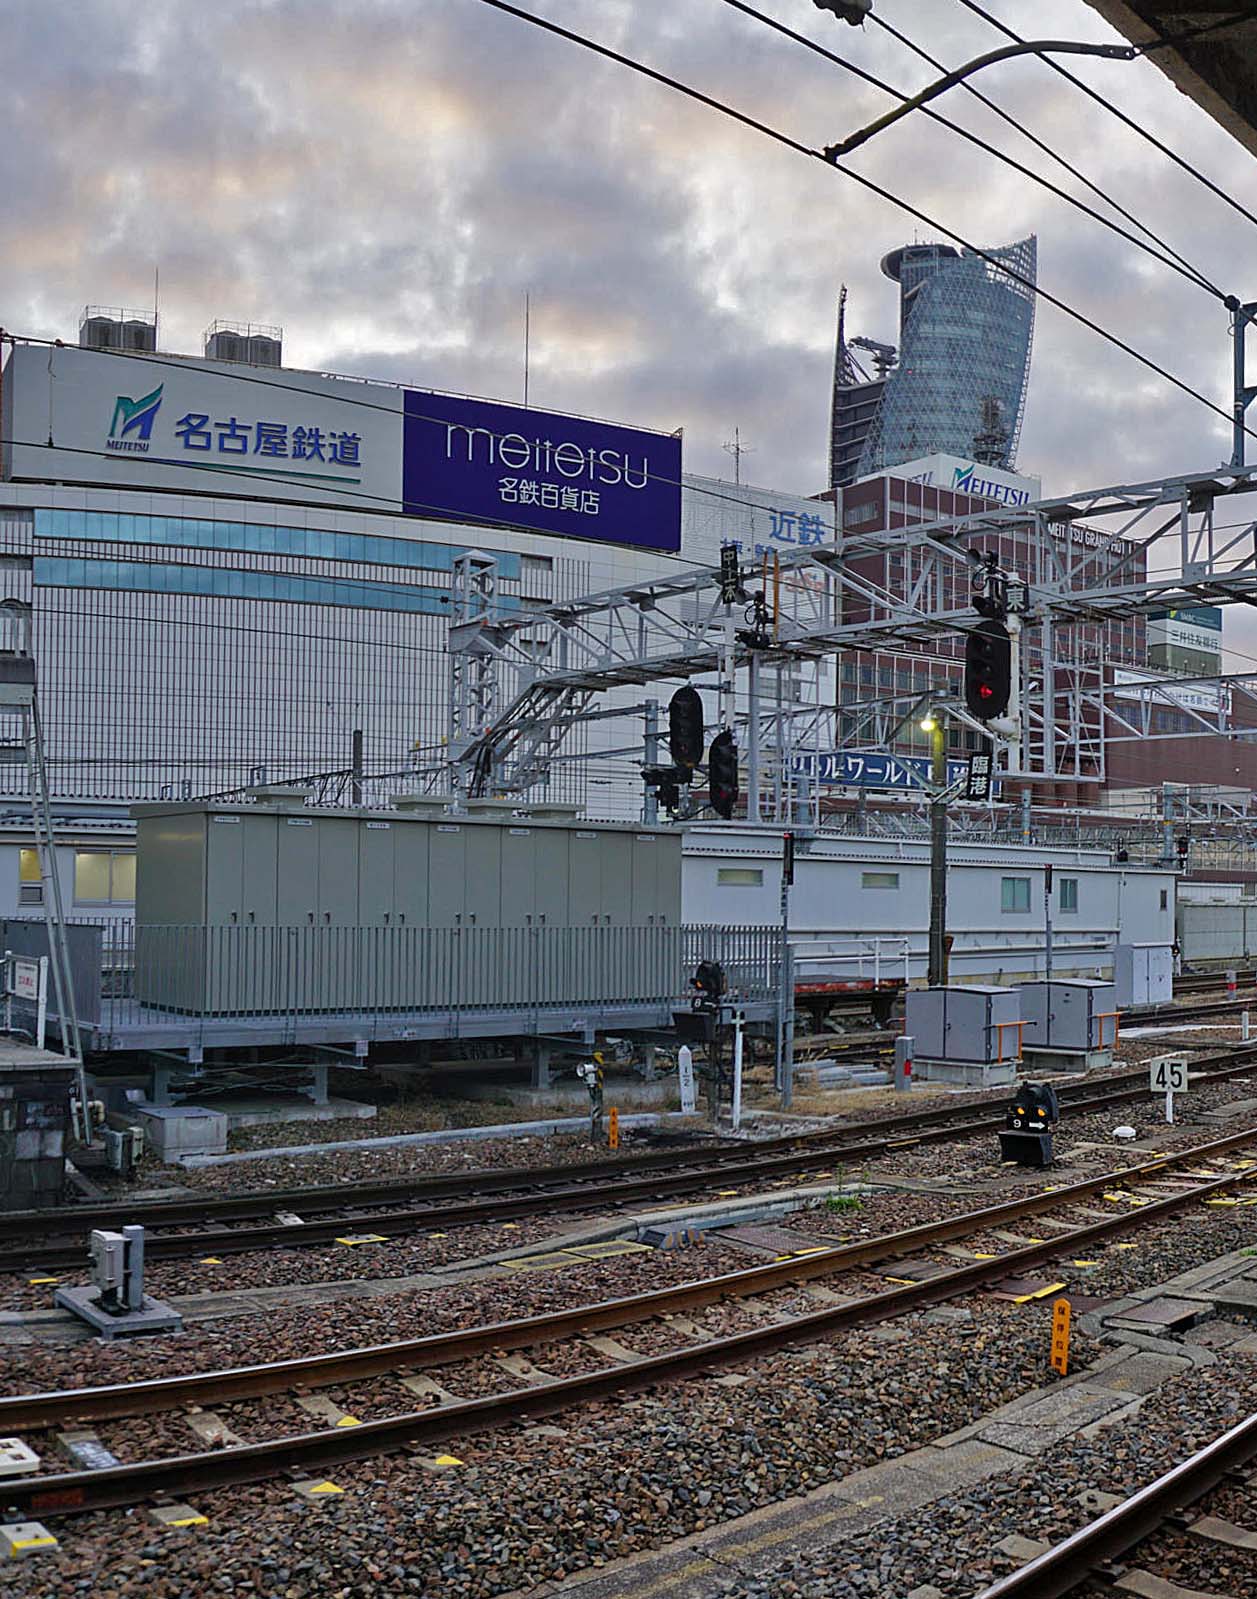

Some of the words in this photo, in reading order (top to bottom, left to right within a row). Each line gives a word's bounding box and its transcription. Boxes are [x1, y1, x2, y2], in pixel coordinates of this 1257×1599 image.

[106, 438, 149, 452] MEITETSU
[174, 412, 362, 468] 名古屋鉄道
[446, 423, 649, 489] meitetsu
[498, 477, 600, 515] 名鉄百貨店
[951, 464, 1030, 506] MEITETSU
[769, 507, 826, 546] 近鉄
[1047, 522, 1083, 544] MEITTSU
[1006, 586, 1025, 611] 東
[969, 755, 990, 795] 臨港
[1155, 1062, 1183, 1089] 45
[1013, 1119, 1022, 1129] 9
